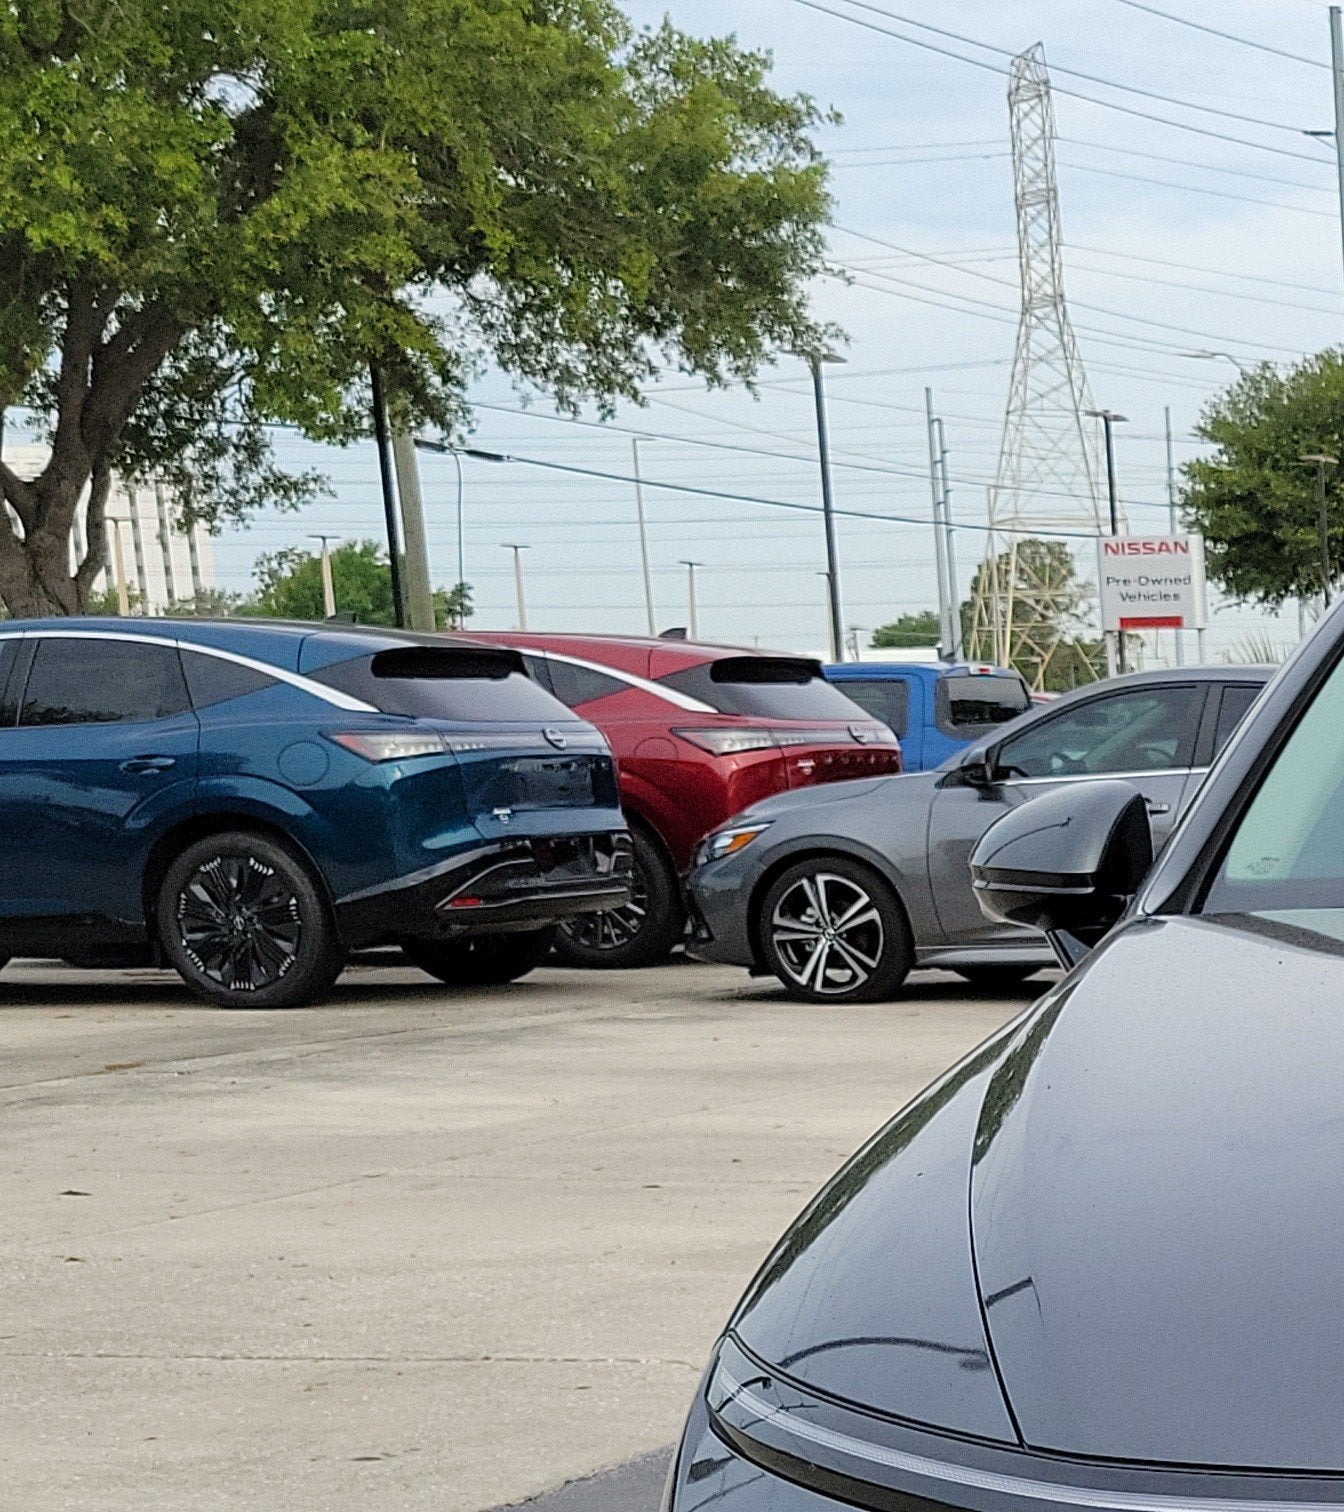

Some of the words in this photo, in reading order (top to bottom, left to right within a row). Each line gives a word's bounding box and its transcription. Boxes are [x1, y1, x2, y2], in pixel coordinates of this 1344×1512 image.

[1104, 541, 1189, 556] NISSAN
[1106, 575, 1192, 587] Pre-Owned
[1120, 591, 1181, 603] Vehicles
